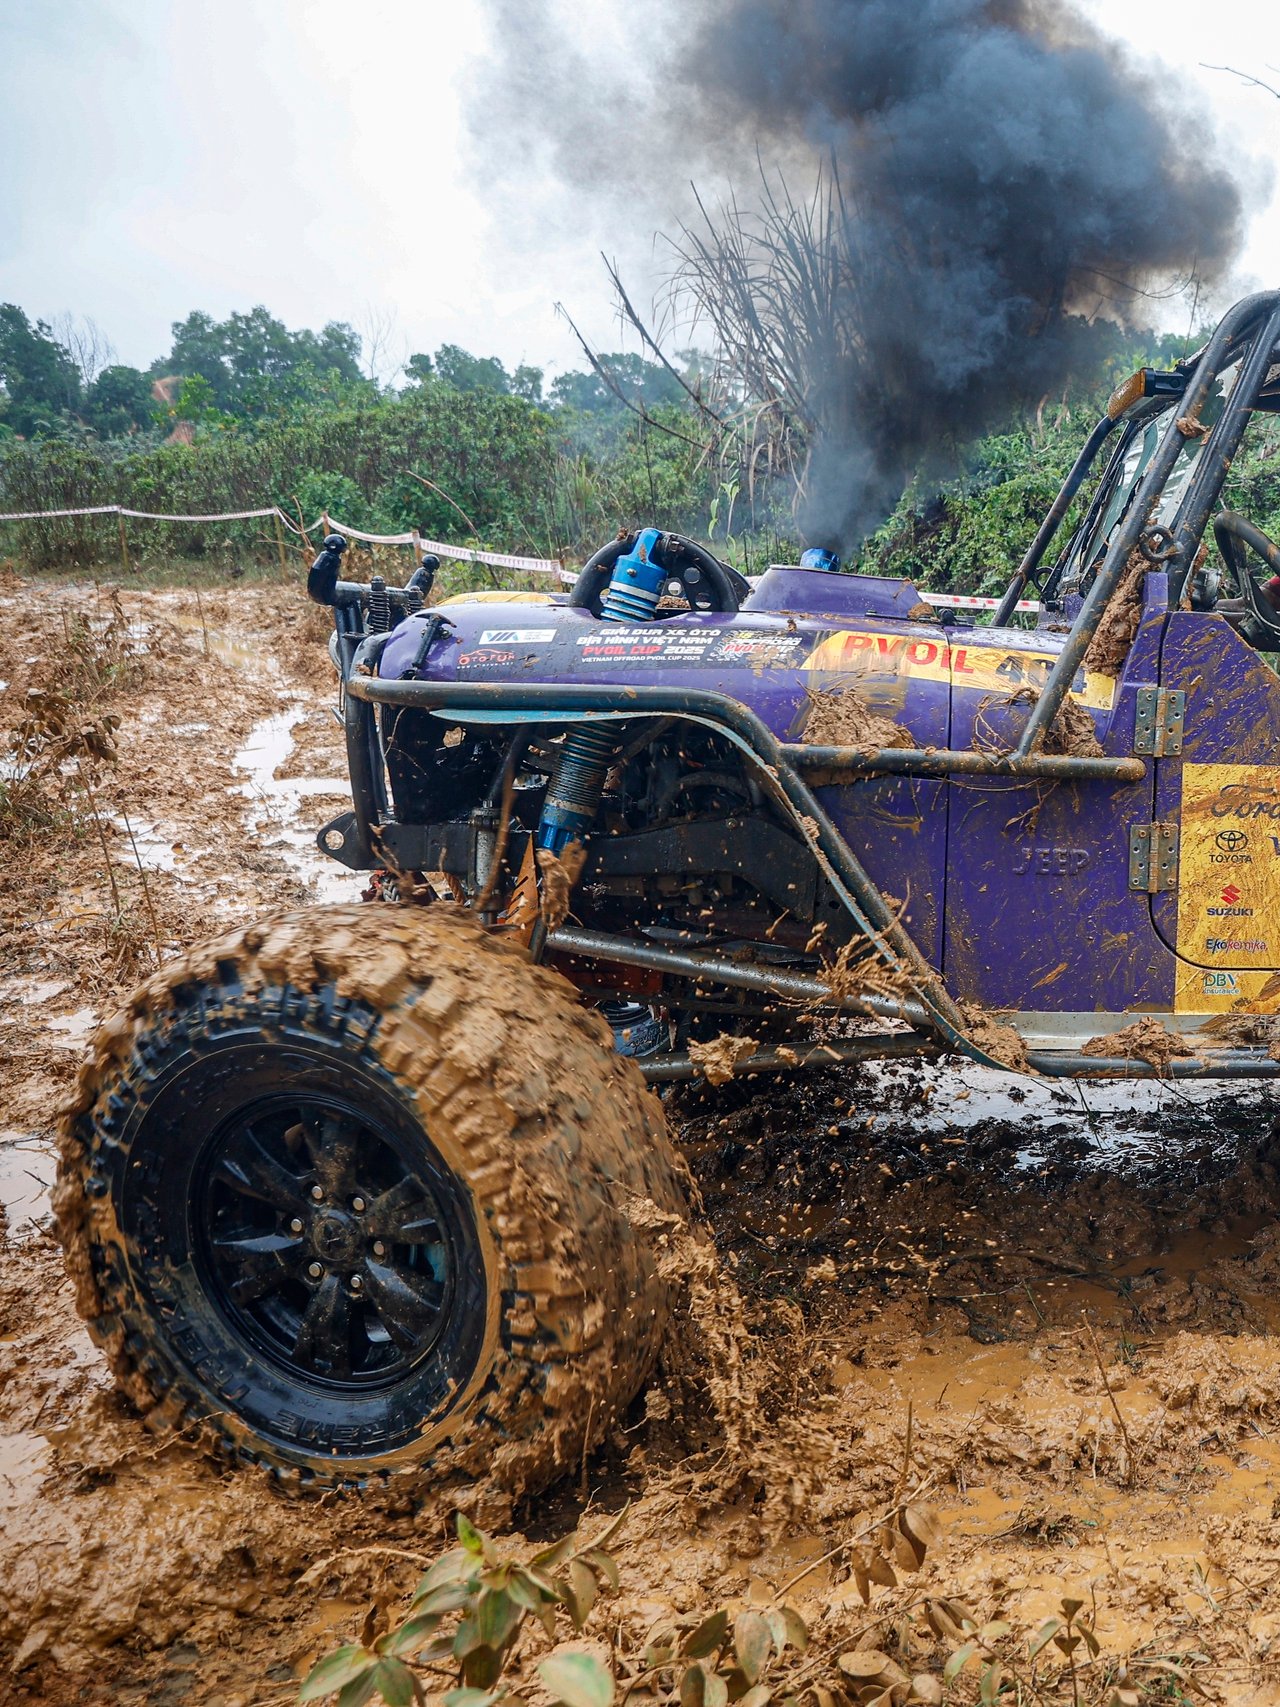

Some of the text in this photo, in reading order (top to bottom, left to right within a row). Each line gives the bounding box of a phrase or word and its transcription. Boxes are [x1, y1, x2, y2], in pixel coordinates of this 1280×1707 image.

[665, 628, 687, 636] XE
[604, 635, 640, 645] HÌNH
[680, 637, 714, 645] NAM
[582, 645, 707, 656] PVOIL CUP 2025
[842, 635, 975, 674] PVOIL
[1012, 847, 1090, 875] JEEP
[1208, 854, 1253, 864] TOYOTA
[1206, 907, 1254, 917] SUZUKI
